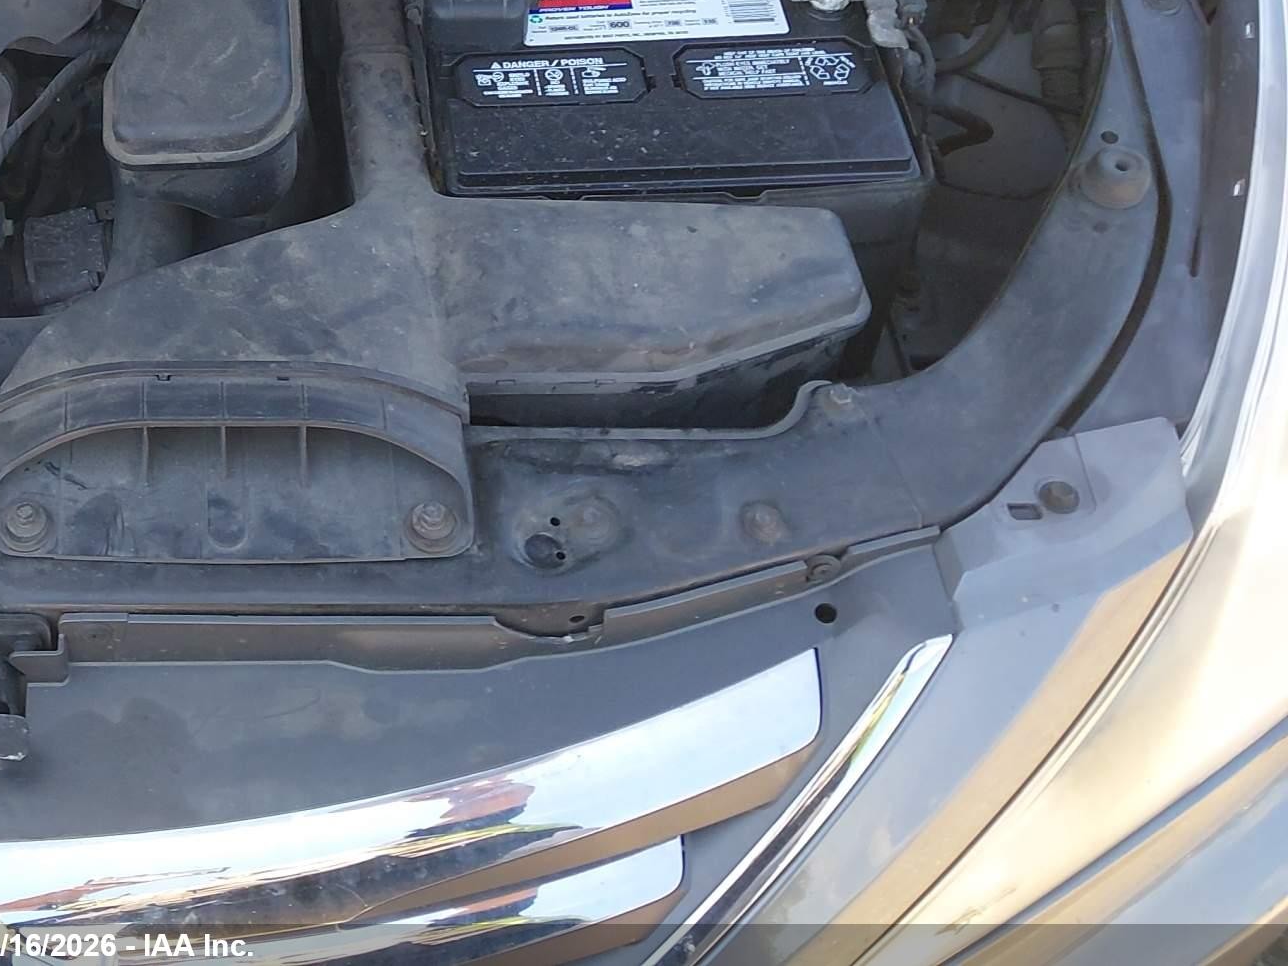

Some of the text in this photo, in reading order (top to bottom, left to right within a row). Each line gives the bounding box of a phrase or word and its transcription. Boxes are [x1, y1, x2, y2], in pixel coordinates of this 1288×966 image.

[609, 20, 630, 28] 600
[502, 59, 550, 69] DANGER
[560, 57, 604, 67] POISON
